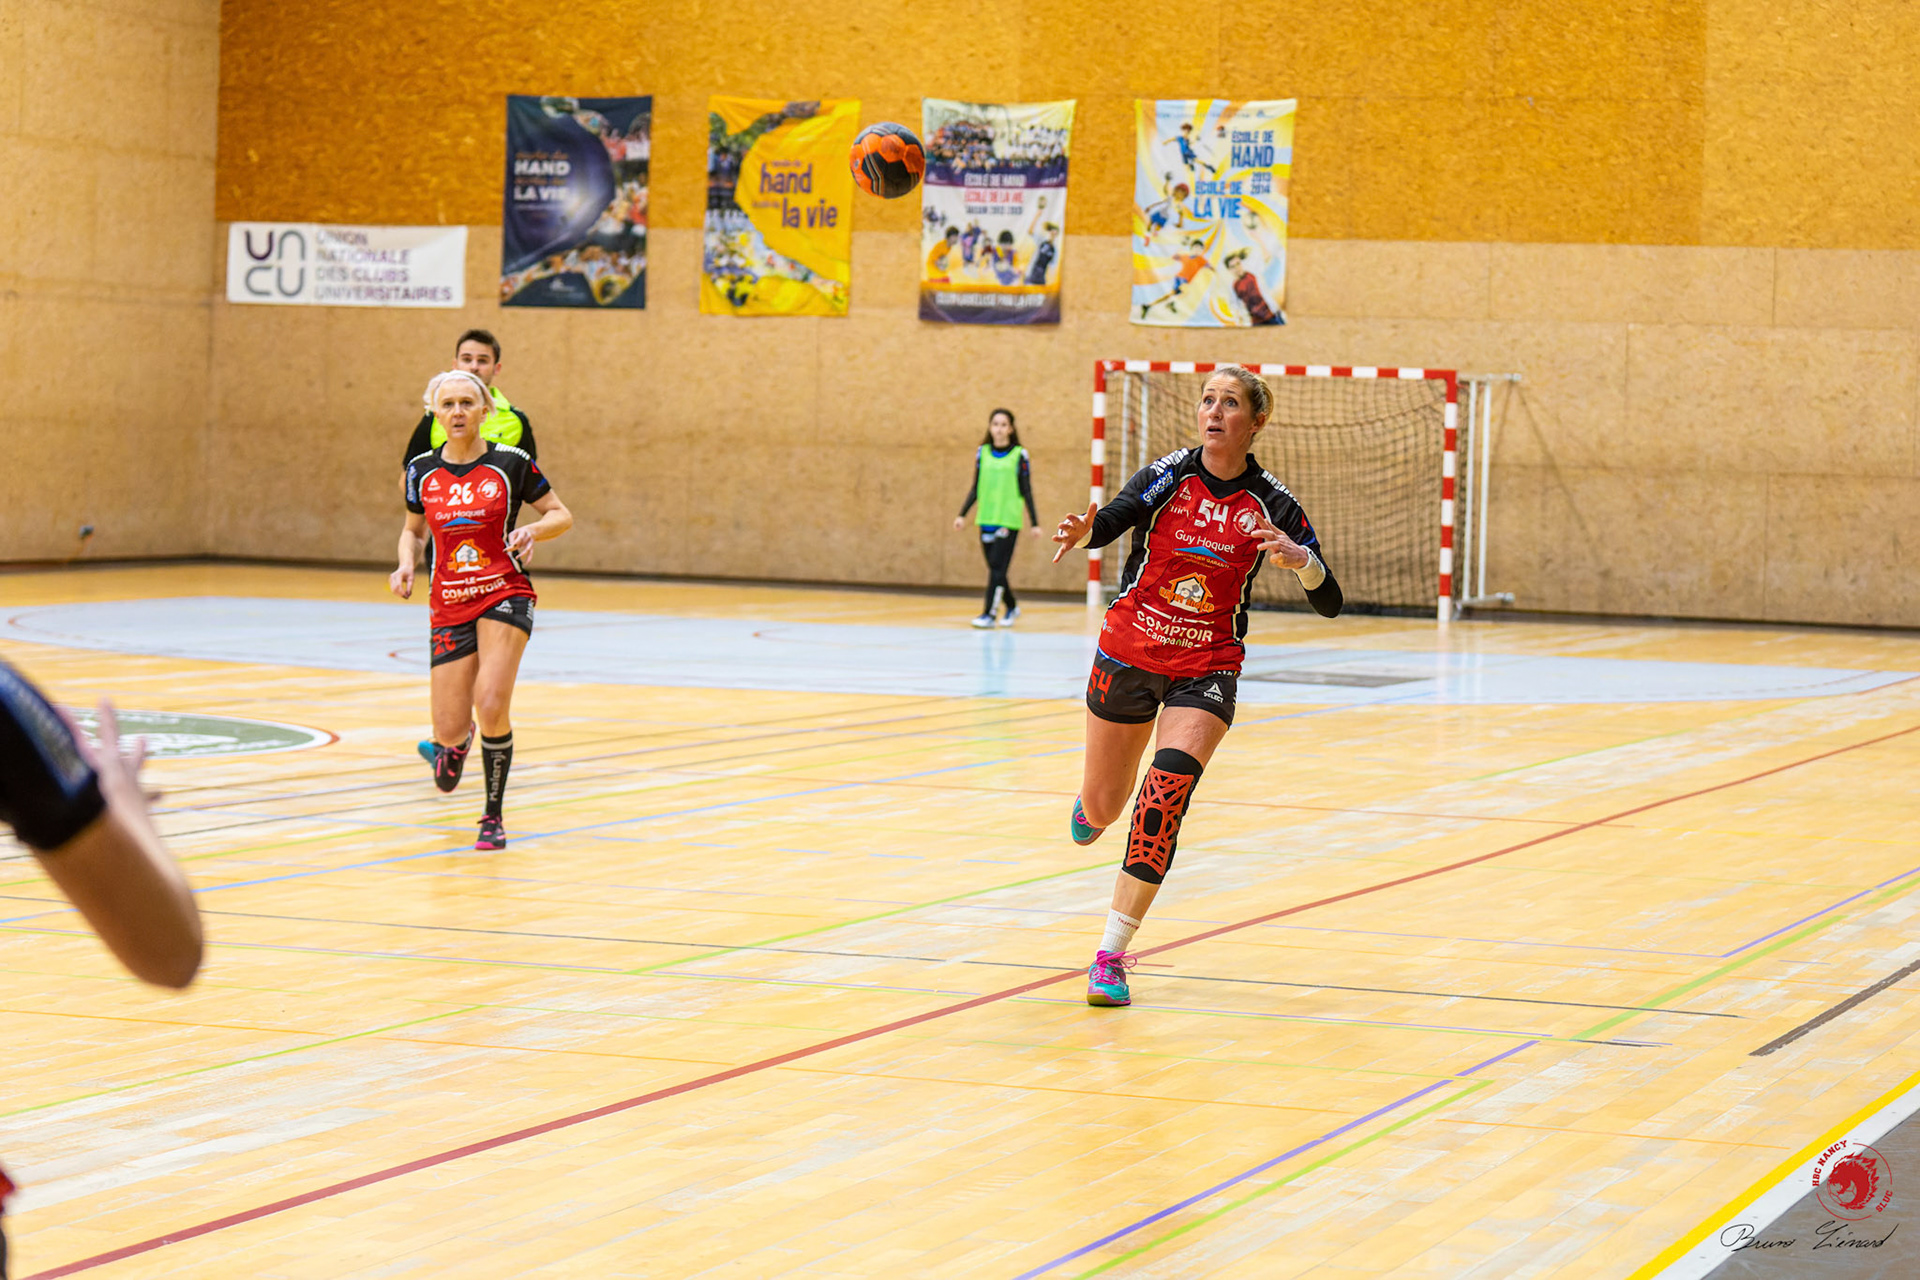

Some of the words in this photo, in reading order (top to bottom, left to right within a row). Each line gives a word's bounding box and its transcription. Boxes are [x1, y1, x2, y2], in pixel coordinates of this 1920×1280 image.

[1262, 130, 1274, 143] DE
[1231, 145, 1274, 167] HAND
[514, 160, 571, 176] HAND
[760, 163, 812, 194] hand
[514, 186, 538, 200] LA
[538, 186, 570, 200] VIE
[1229, 181, 1242, 195] DE
[1250, 184, 1270, 194] 2014
[782, 197, 799, 228] la
[806, 198, 837, 228] vie
[1194, 198, 1212, 218] LA
[1218, 198, 1242, 218] VIE
[317, 231, 367, 246] UNION
[317, 248, 410, 264] NATIONALE
[317, 267, 348, 282] DES
[352, 268, 408, 283] CLUBS
[315, 285, 453, 301] UNIVERSITAIRES
[447, 482, 474, 506] 26
[435, 511, 451, 521] Guy
[452, 508, 486, 518] Hoquet
[1194, 499, 1229, 533] 54
[1175, 530, 1195, 545] Guy
[1197, 536, 1236, 553] Hoquet
[442, 578, 507, 599] COMPTOIR
[1137, 610, 1213, 642] COMPTOIR
[1172, 615, 1182, 623] LE
[432, 632, 456, 655] 26
[1146, 628, 1194, 648] Campanile
[1088, 665, 1113, 704] 54
[1203, 691, 1224, 703] SELECT
